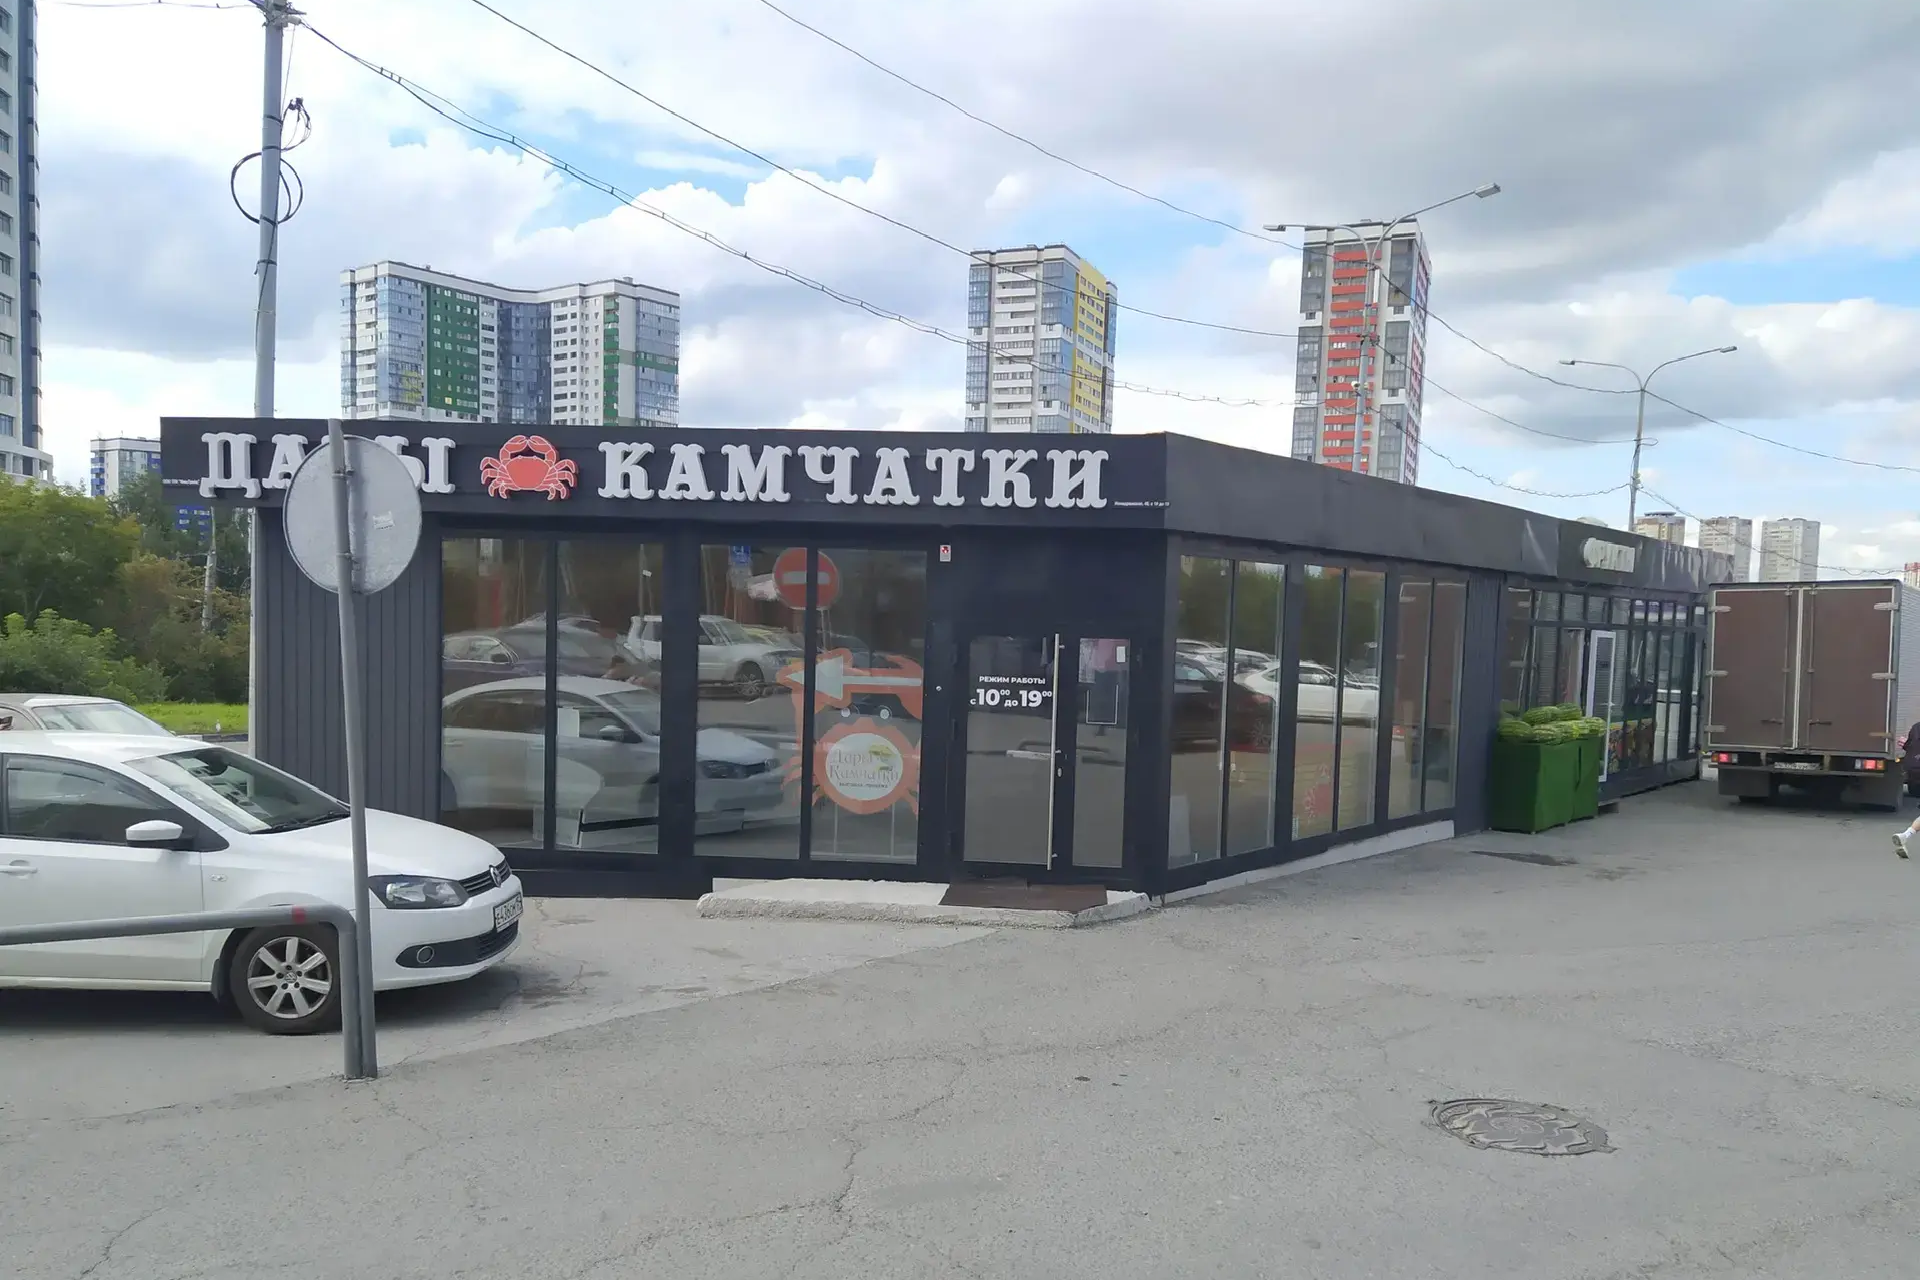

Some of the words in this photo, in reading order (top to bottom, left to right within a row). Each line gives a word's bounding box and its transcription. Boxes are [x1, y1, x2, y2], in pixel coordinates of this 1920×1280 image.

[199, 432, 456, 498] ДАЫ
[598, 441, 1109, 508] КАМЧАТКИ
[1004, 699, 1019, 707] до
